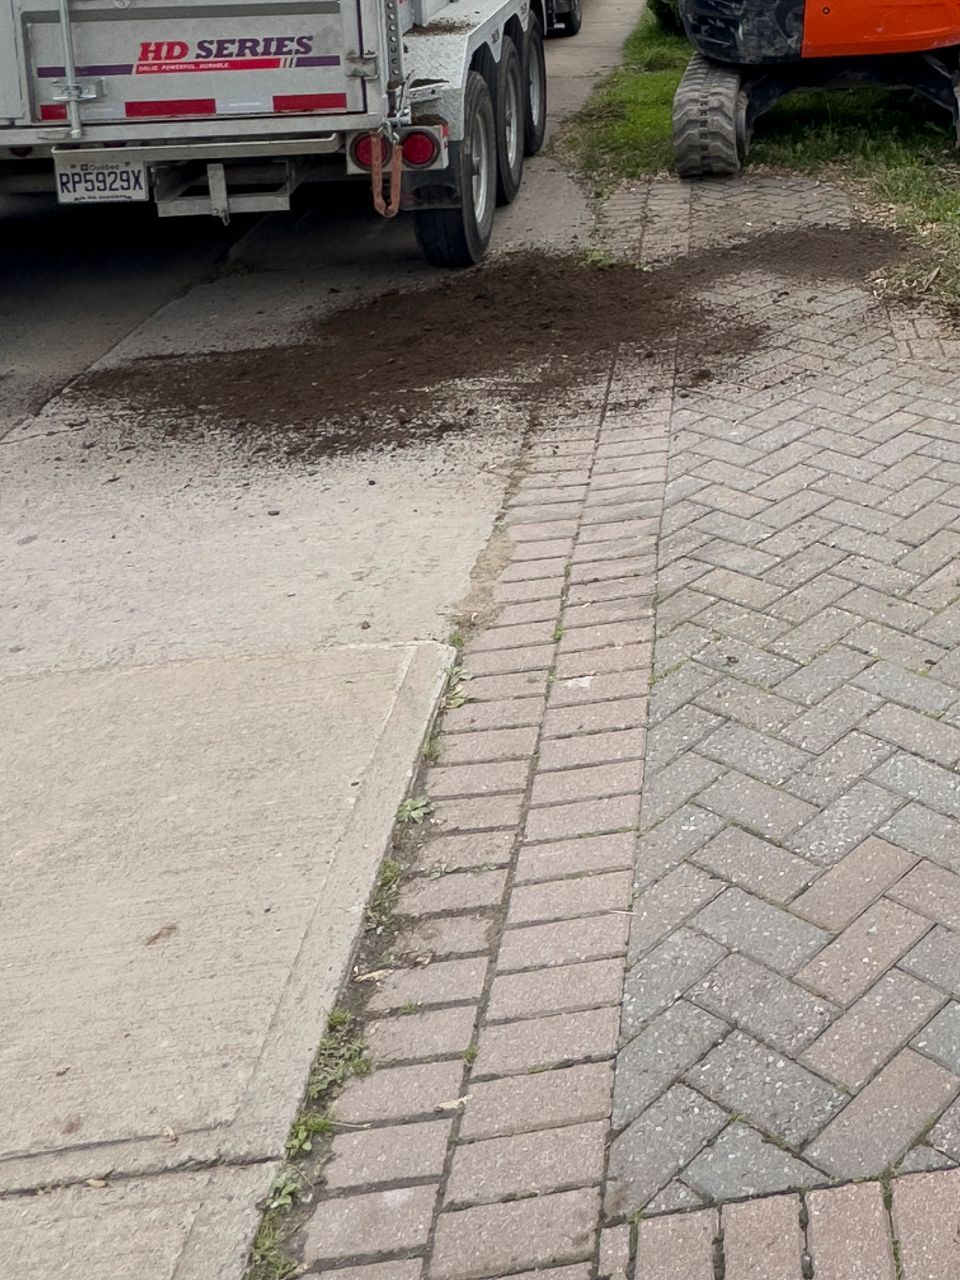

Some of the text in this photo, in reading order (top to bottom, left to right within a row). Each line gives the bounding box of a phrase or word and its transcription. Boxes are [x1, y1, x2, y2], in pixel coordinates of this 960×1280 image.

[139, 37, 313, 61] HD SERIES
[59, 169, 144, 194] RP5929X
